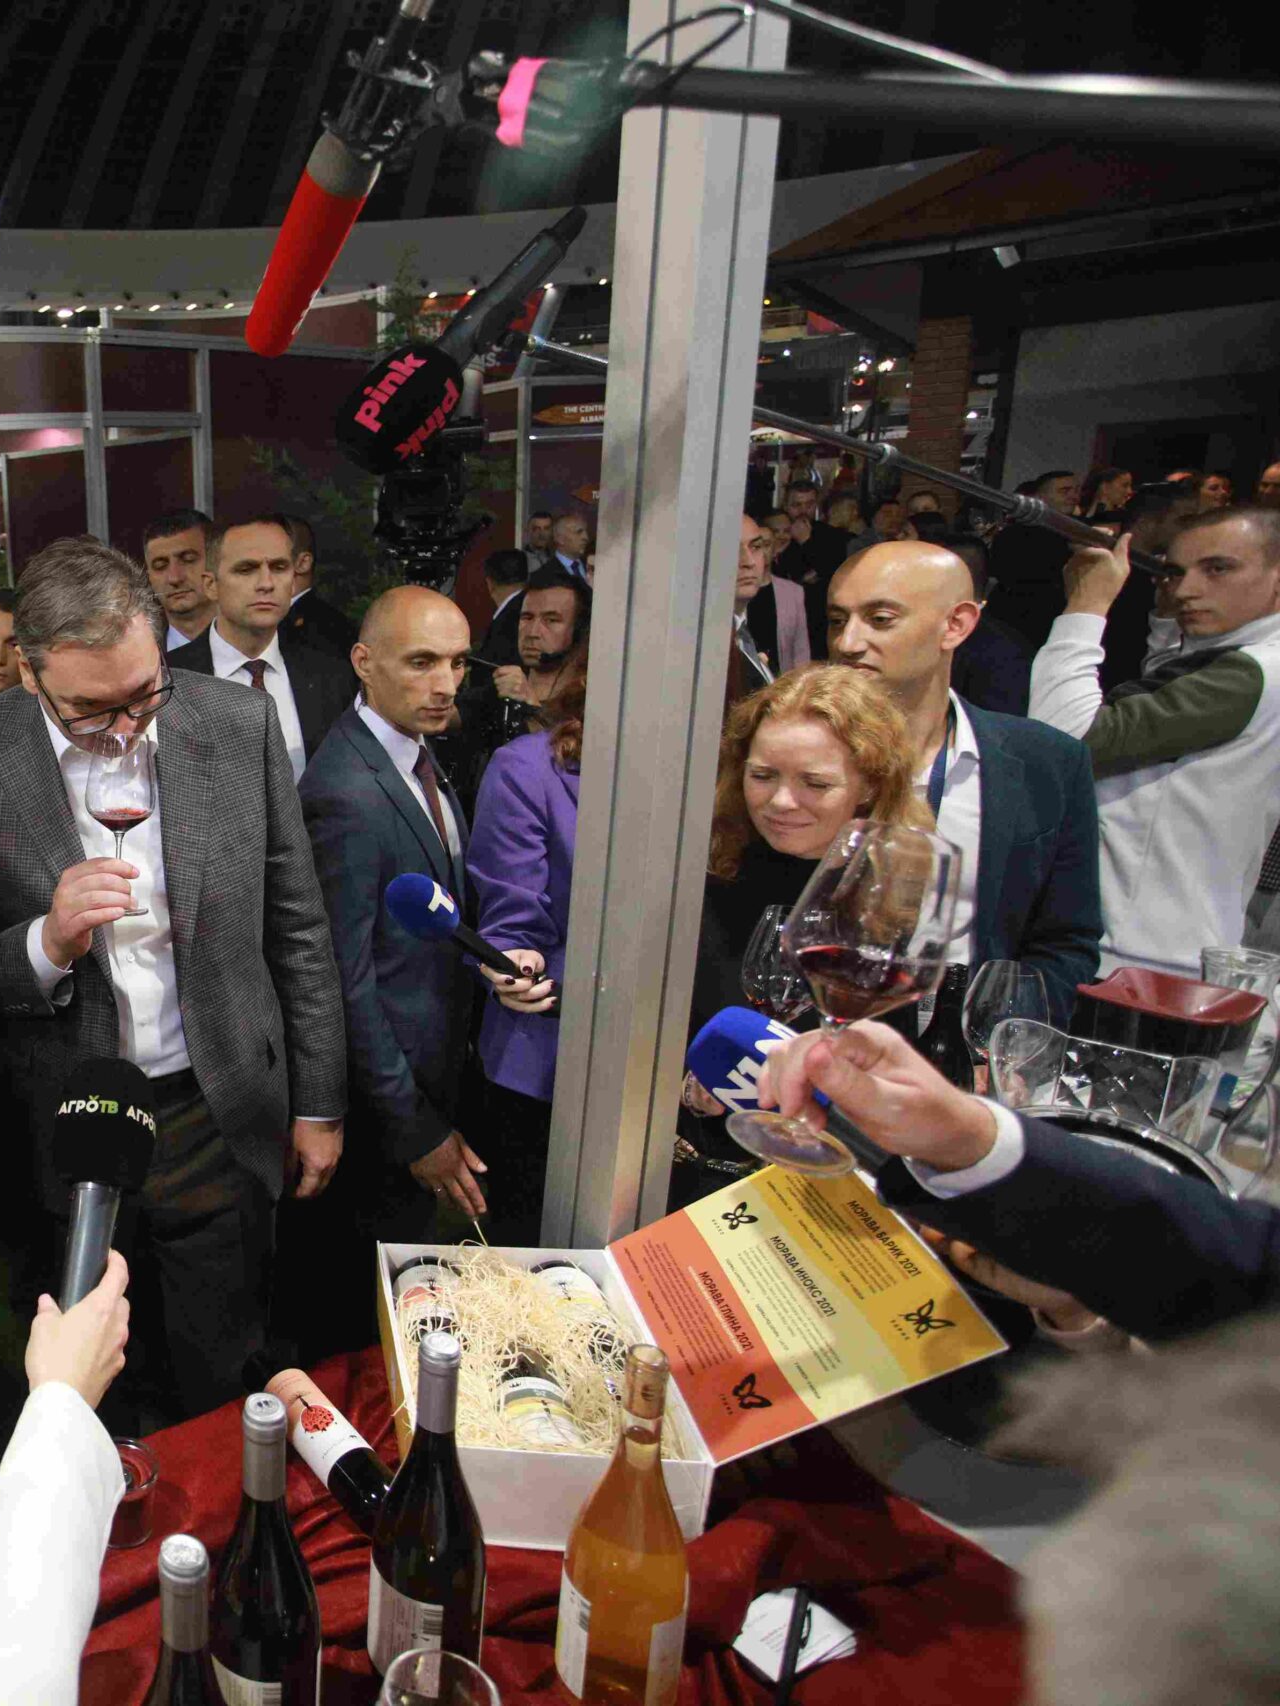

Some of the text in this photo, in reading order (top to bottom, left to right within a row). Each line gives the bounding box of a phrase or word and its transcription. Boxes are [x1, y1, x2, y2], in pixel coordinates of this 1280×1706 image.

[354, 352, 428, 433] pink
[393, 377, 460, 462] pink
[770, 1235, 837, 1317] МОРАВА ИНОКС 2021
[847, 1200, 922, 1278] МОРАВА БАРИК 2021
[699, 1271, 755, 1351] МОРАВА ГЛИНА 2021
